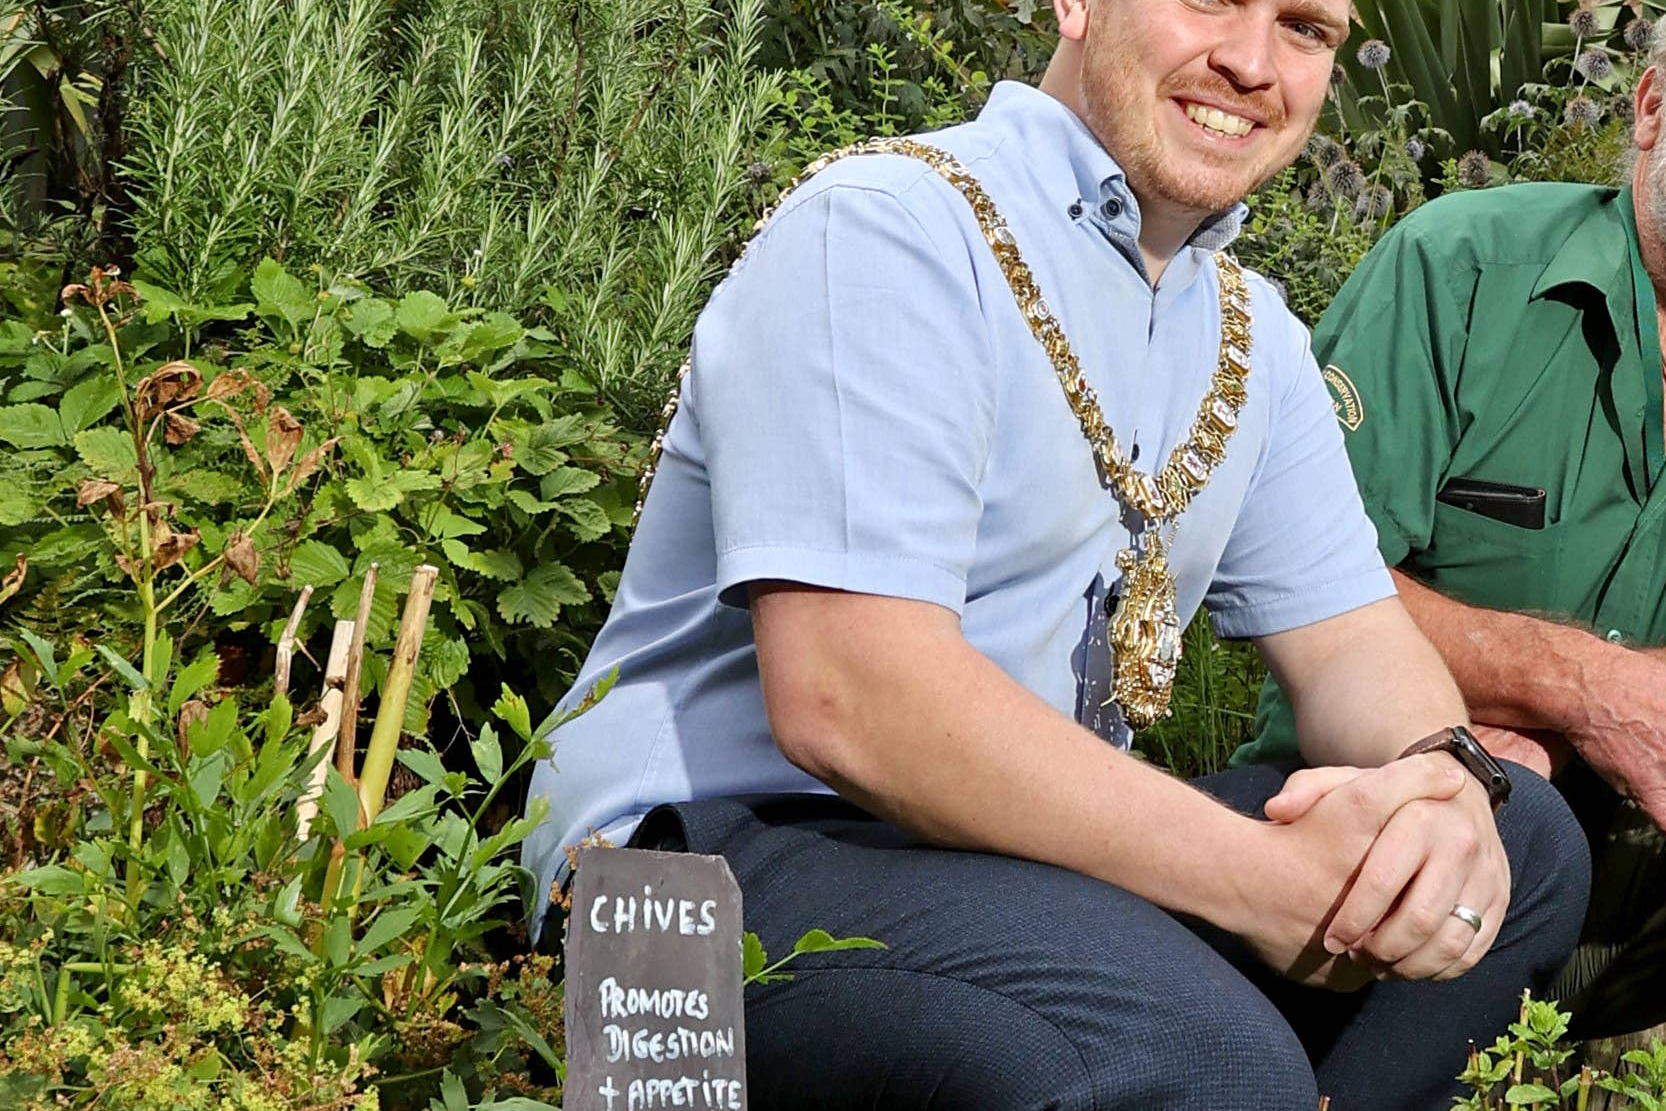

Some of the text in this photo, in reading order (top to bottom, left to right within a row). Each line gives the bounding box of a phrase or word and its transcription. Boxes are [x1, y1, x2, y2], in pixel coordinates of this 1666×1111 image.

[1324, 370, 1358, 423] CONSERVATION
[598, 976, 709, 1020] PROMOTES
[602, 1024, 735, 1063] DIGESTION
[598, 1075, 620, 1111] +
